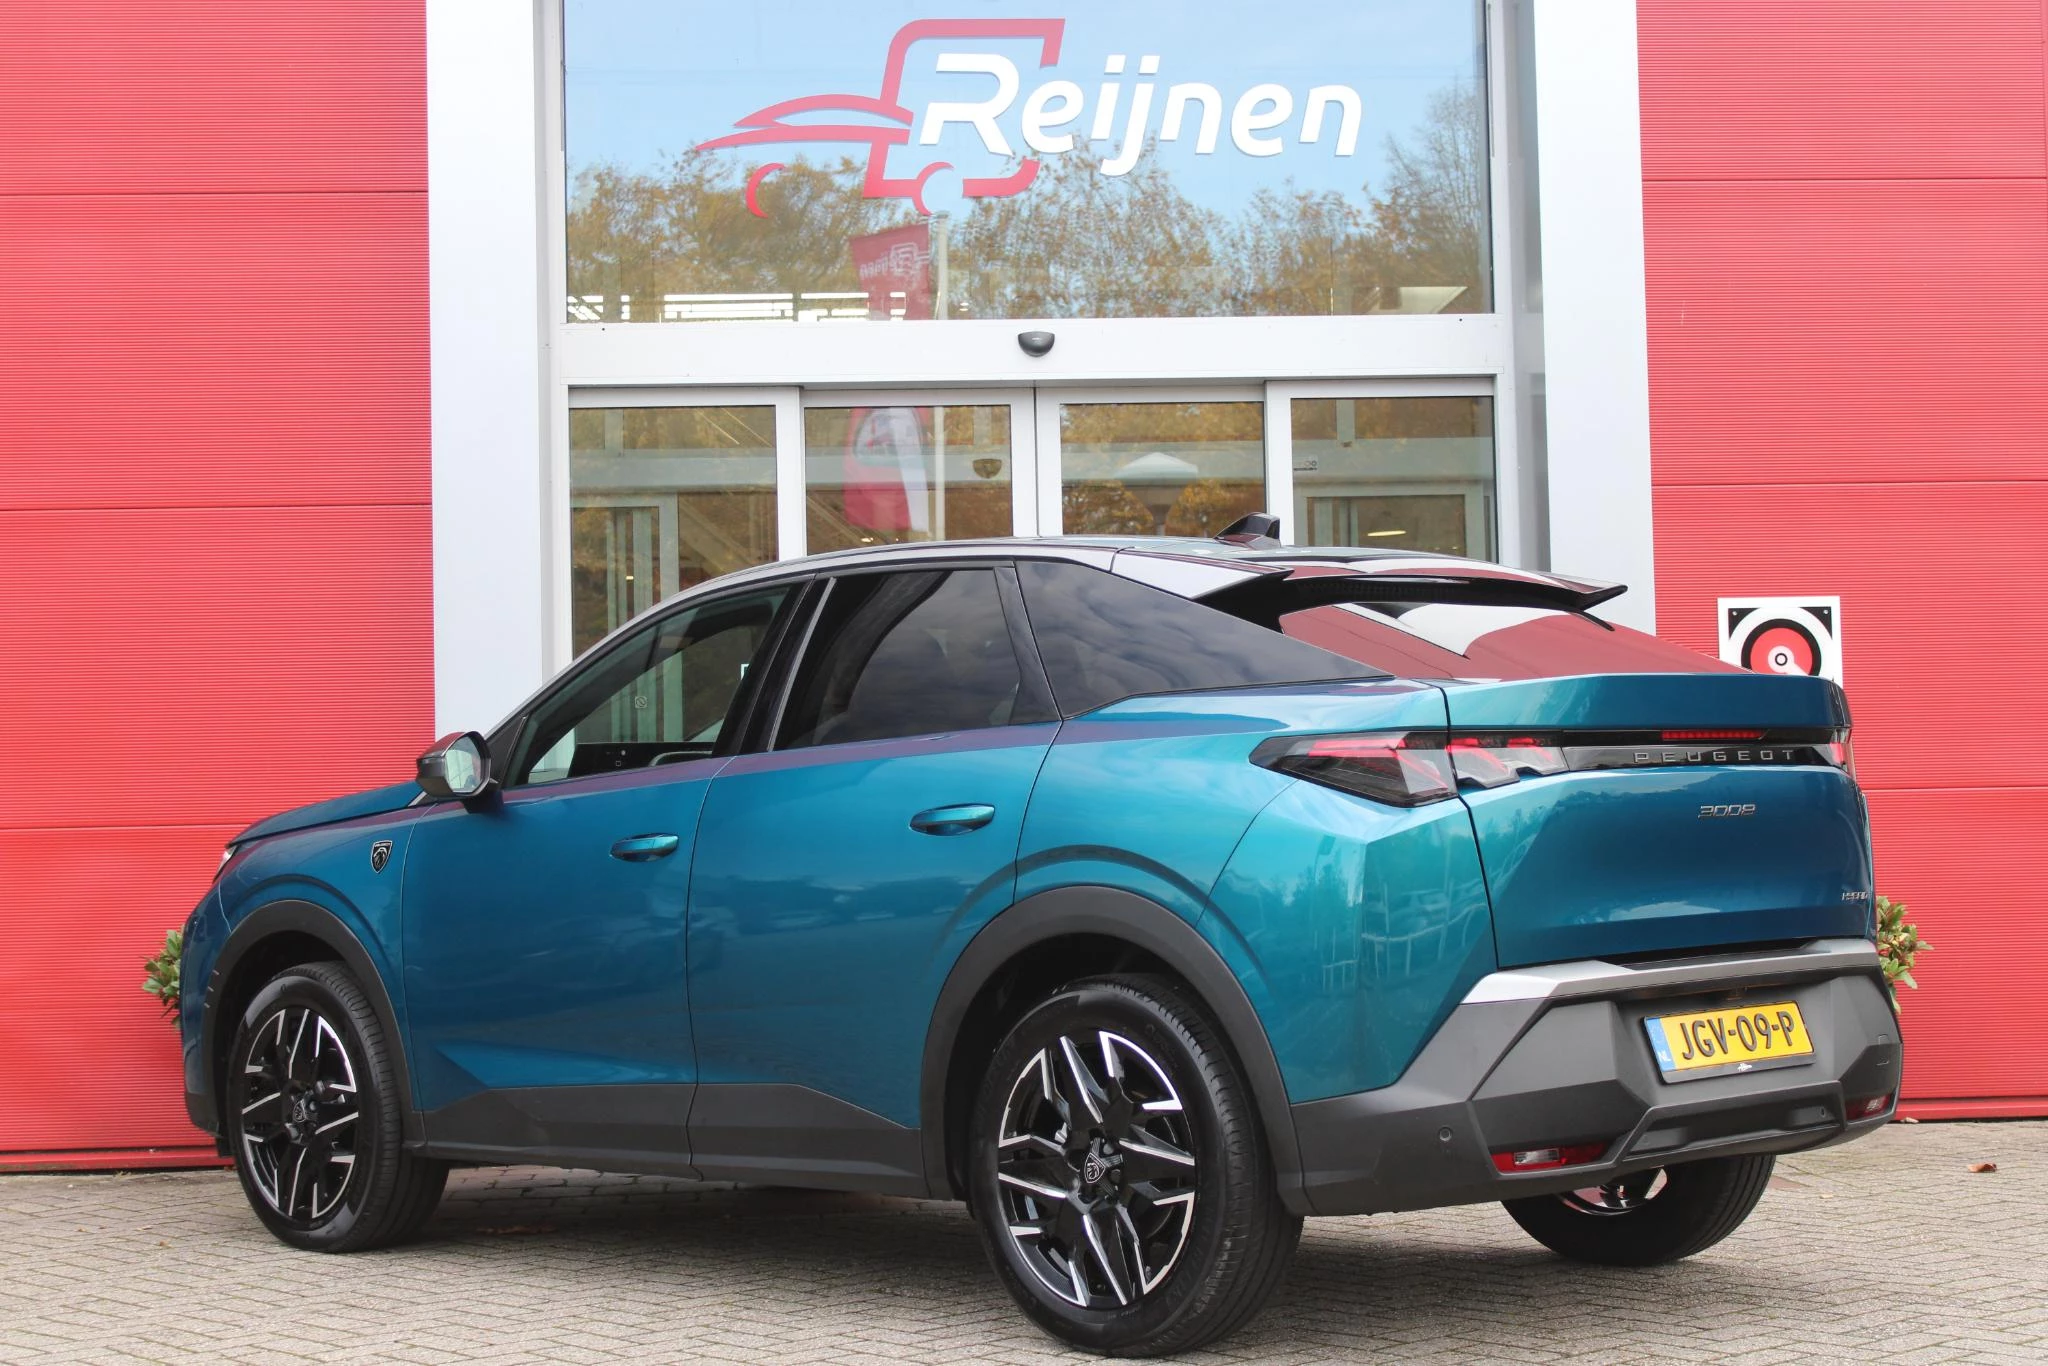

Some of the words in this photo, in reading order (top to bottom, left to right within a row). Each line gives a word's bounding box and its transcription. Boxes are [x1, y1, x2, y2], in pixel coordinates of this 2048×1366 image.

[919, 53, 1362, 176] Reijnen
[1633, 749, 1796, 763] PEUGEOT
[1698, 803, 1756, 819] 3008
[1679, 1010, 1795, 1060] JGV-09-P
[1658, 1051, 1672, 1063] NL
